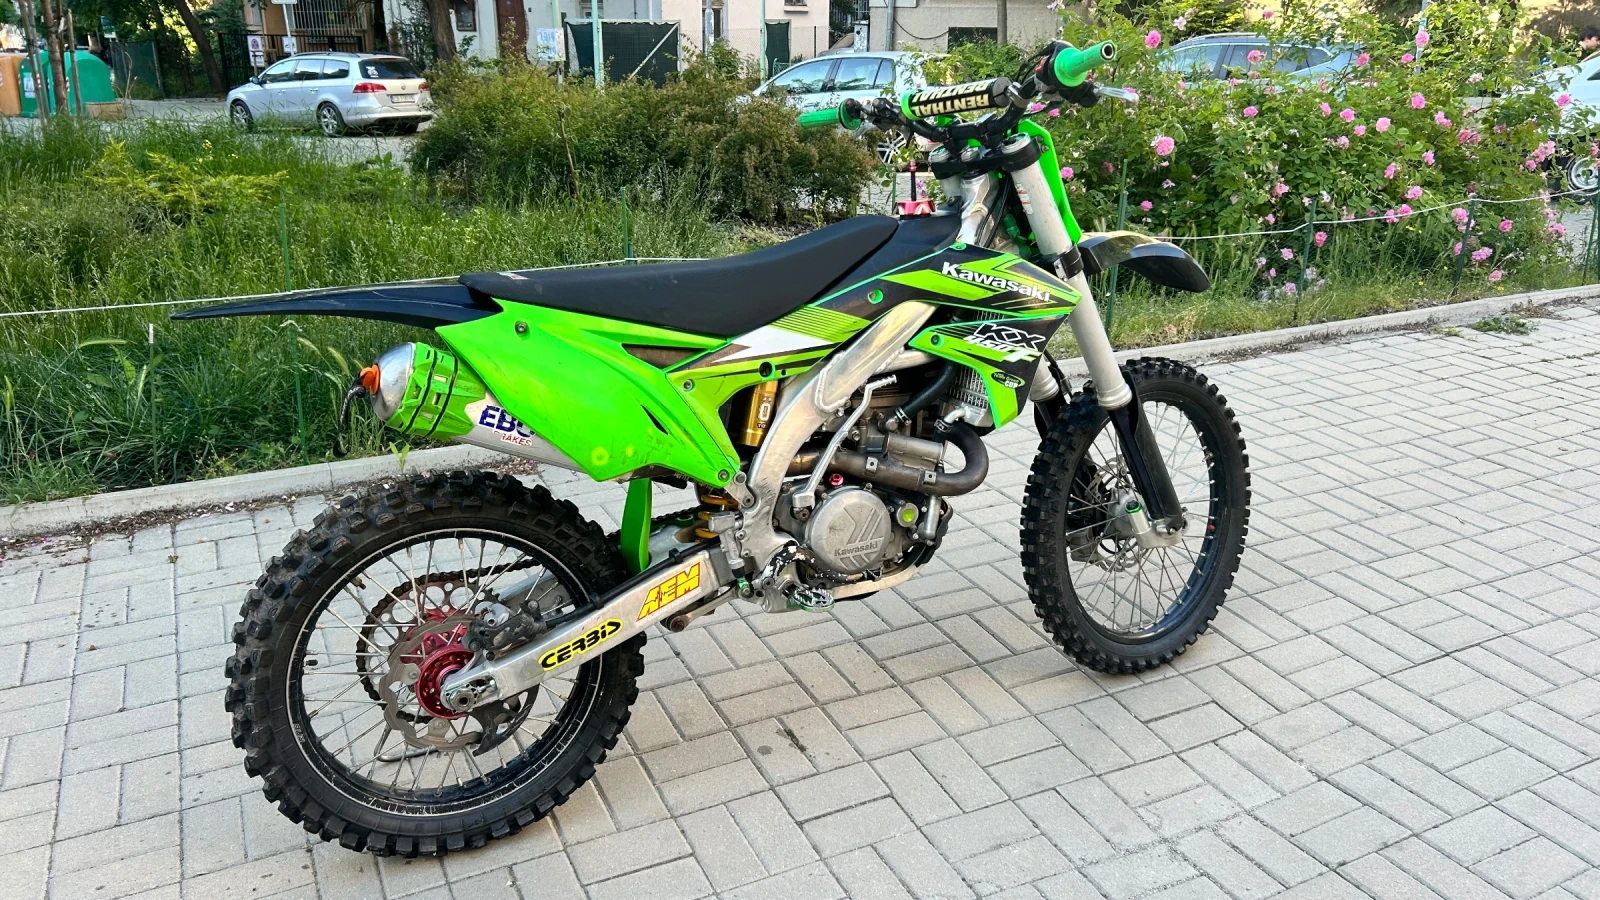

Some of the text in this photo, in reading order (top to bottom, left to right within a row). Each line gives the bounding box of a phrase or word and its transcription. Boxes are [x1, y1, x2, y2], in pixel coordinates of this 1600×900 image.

[911, 82, 988, 102] RENTHAL
[911, 94, 989, 116] RENTHAL
[942, 261, 1051, 302] Kawasaki
[974, 322, 1046, 351] KX
[494, 431, 532, 446] RAKES
[834, 541, 878, 556] Kawasaki
[636, 561, 701, 622] AEM
